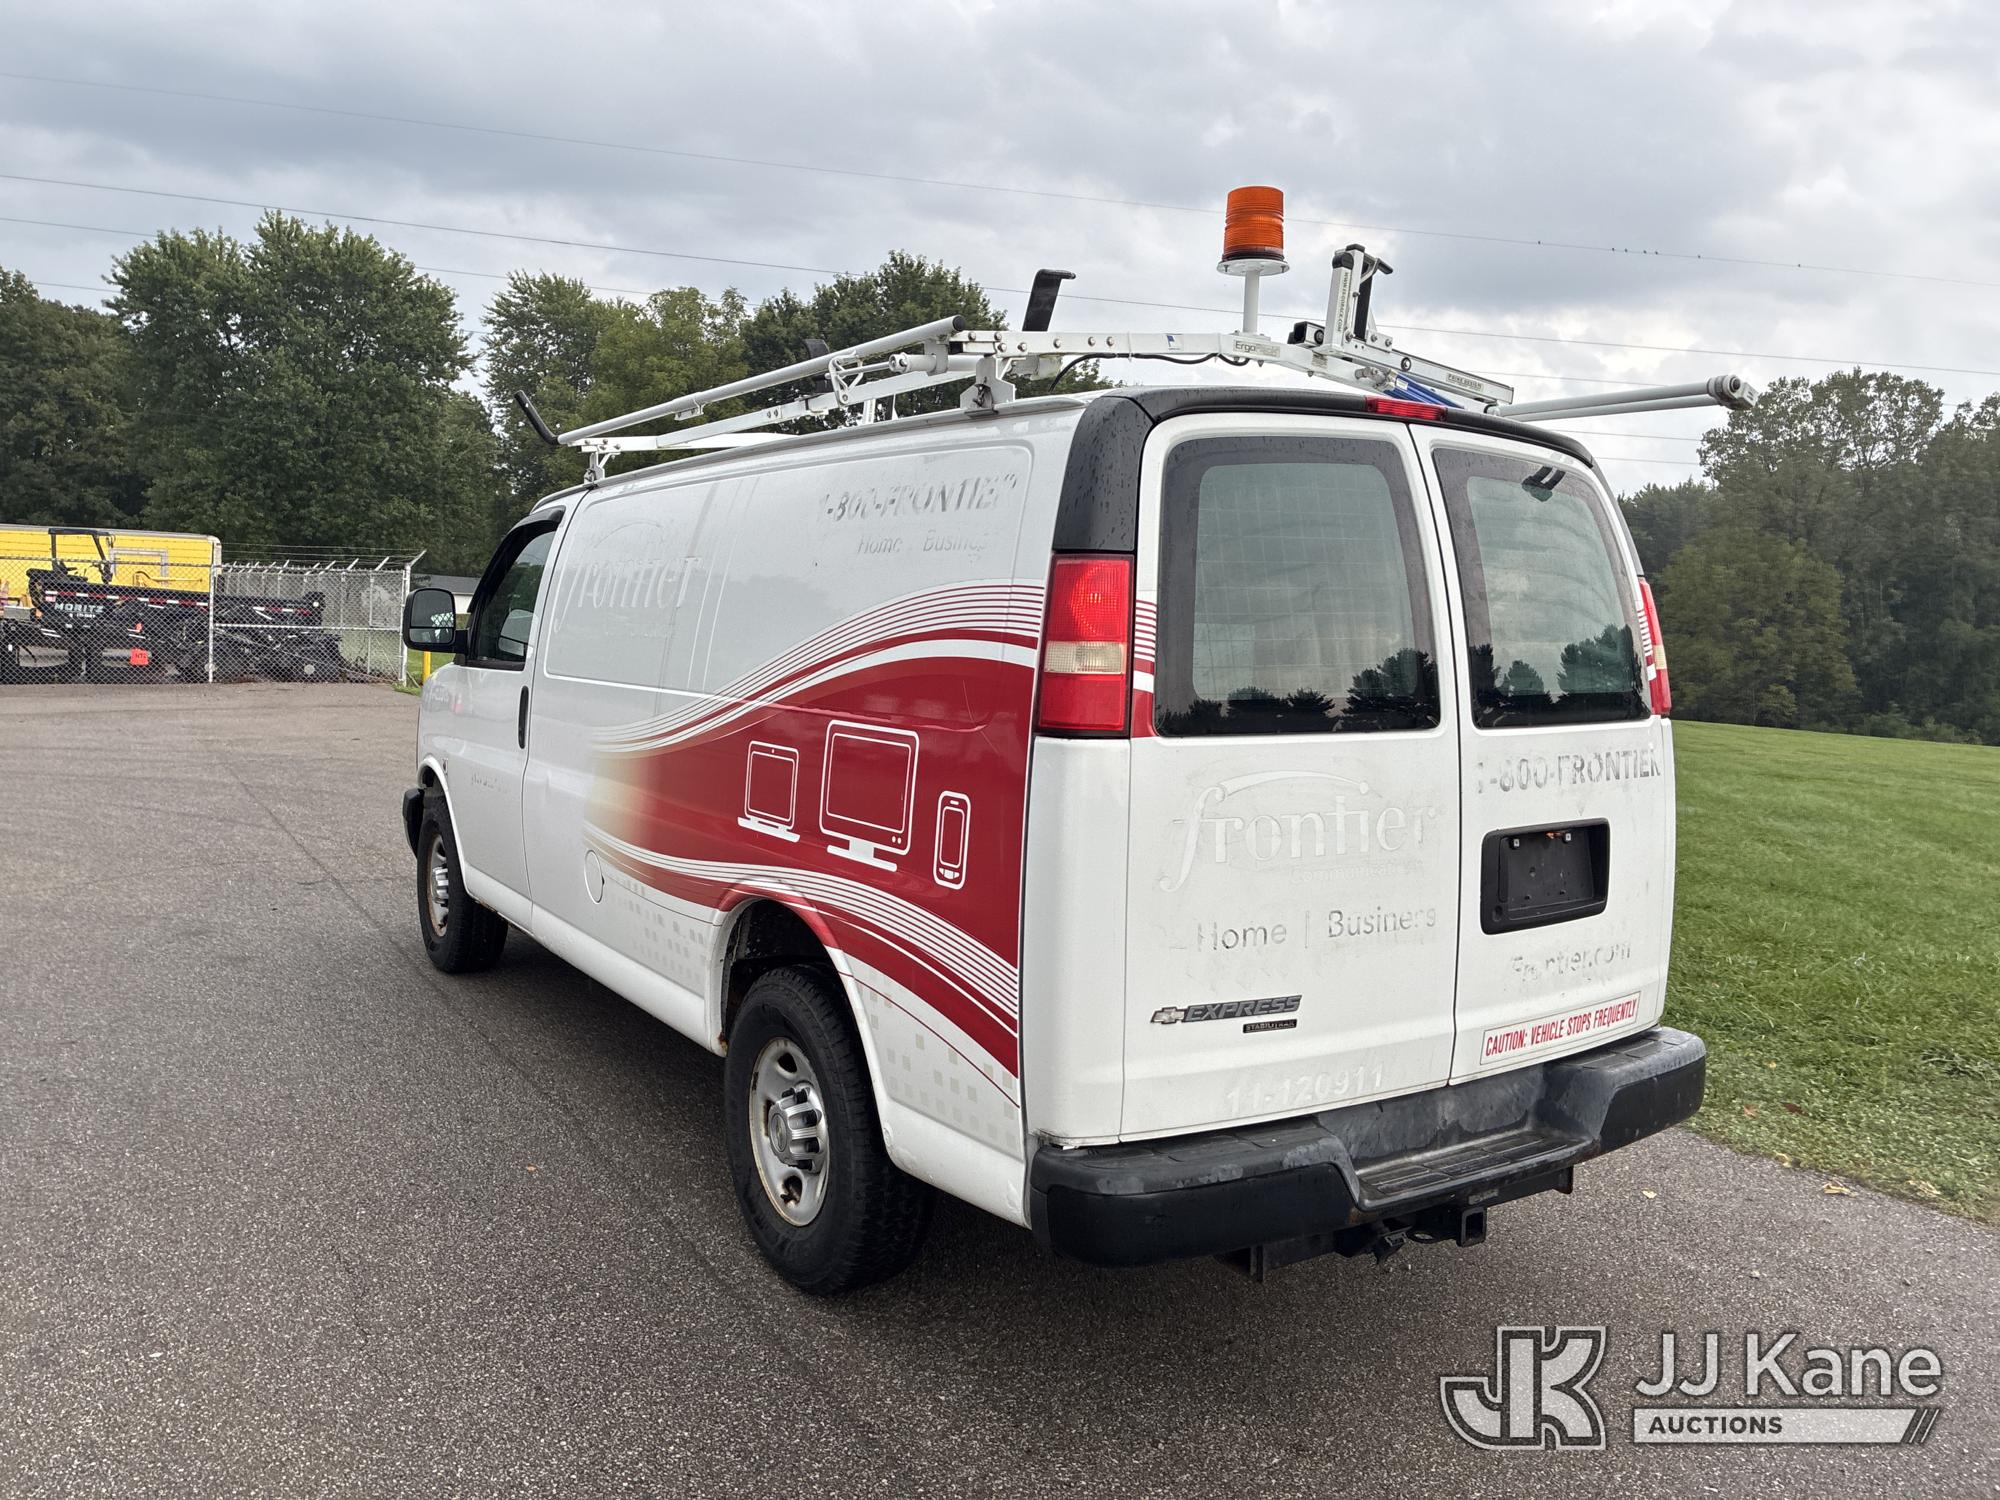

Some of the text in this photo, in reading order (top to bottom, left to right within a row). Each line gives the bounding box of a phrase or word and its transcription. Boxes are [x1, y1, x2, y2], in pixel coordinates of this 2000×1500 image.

[54, 602, 104, 613] MORITZ
[1159, 785, 1437, 892] frontier
[1197, 922, 1287, 952] Home
[1185, 995, 1301, 1022] EXPRESS
[1485, 999, 1637, 1057] CAUTION: VEHICLE STOPS FREQUENTLY
